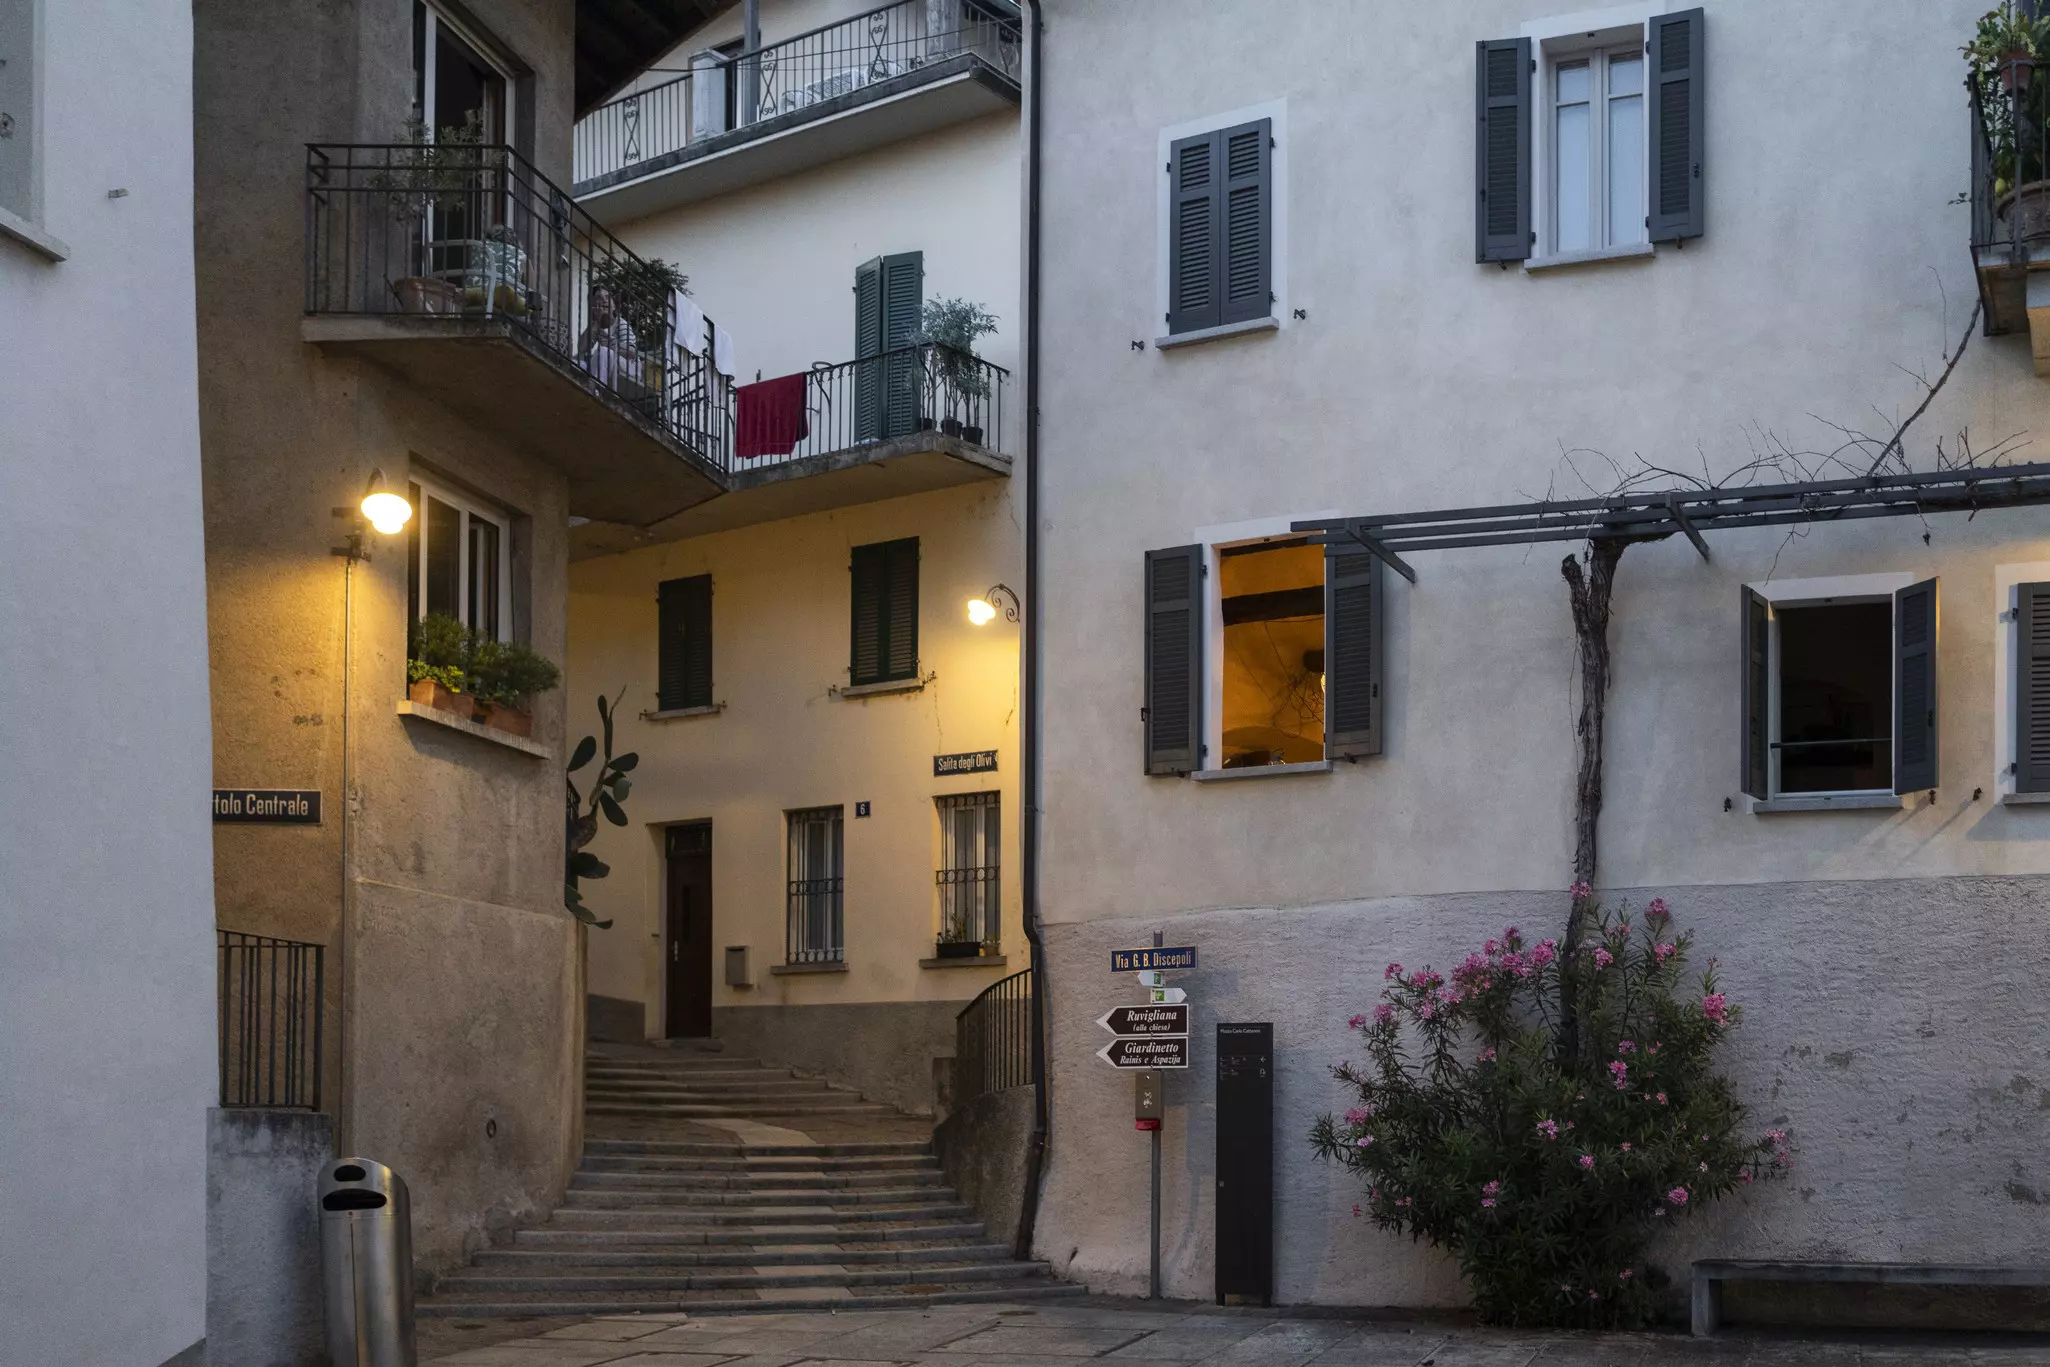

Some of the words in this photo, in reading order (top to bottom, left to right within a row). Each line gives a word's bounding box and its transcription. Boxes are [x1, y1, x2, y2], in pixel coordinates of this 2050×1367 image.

[938, 757, 958, 771] Salita
[958, 754, 976, 771] degli
[976, 752, 993, 767] Olivi
[246, 794, 309, 815] Centrale
[860, 804, 866, 815] 6
[1115, 954, 1129, 968] Via
[1133, 953, 1141, 968] G.
[1143, 953, 1151, 967] B.
[1153, 951, 1191, 967] Discepoli
[1127, 1010, 1177, 1022] Ruvigliana
[1133, 1023, 1147, 1032] (alla
[1149, 1023, 1171, 1031] chiesa)
[1125, 1042, 1179, 1053] Giardinetto
[1120, 1055, 1142, 1064] Rainis
[1151, 1055, 1181, 1065] Aspazija
